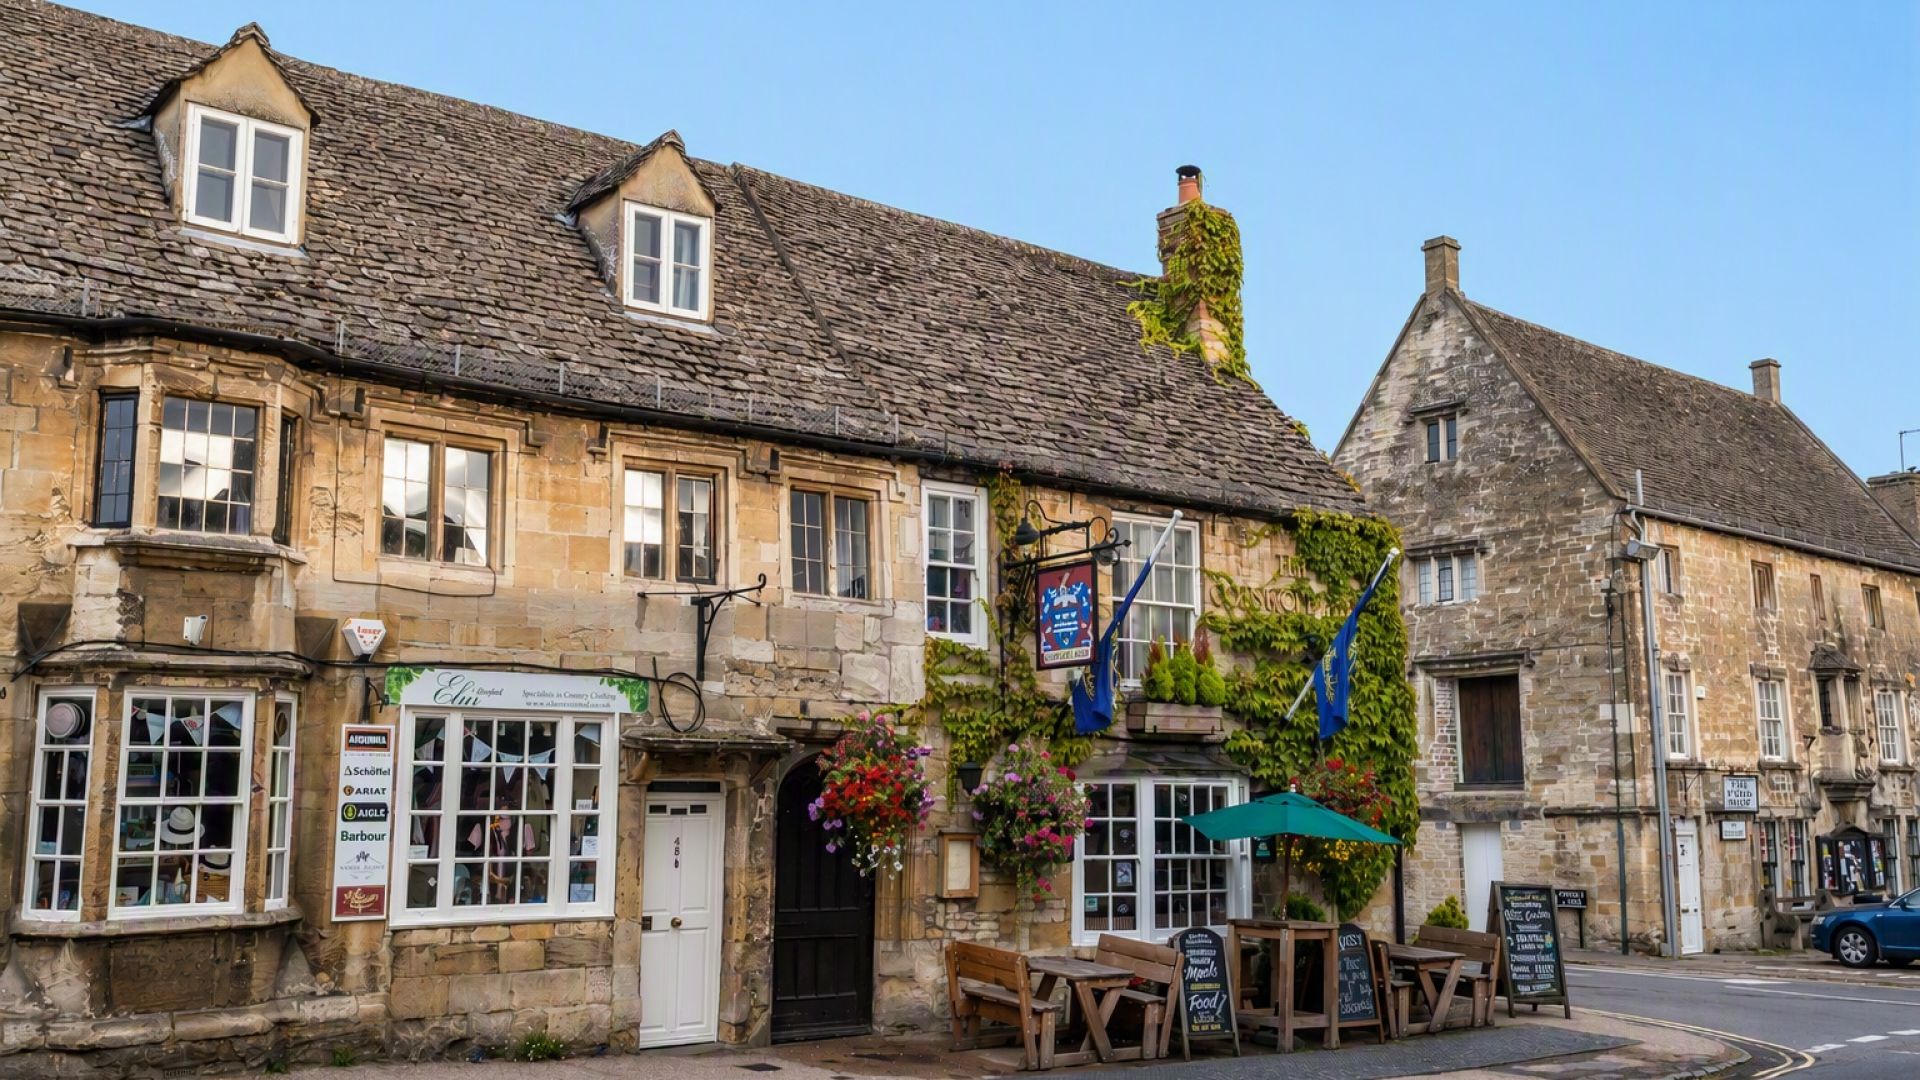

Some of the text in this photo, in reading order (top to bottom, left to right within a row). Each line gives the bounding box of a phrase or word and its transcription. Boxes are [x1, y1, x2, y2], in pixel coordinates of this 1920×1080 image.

[355, 787, 387, 795] ARIAT
[358, 809, 386, 818] AIGLE
[340, 830, 387, 842] Barbour
[1188, 991, 1221, 1011] Food
